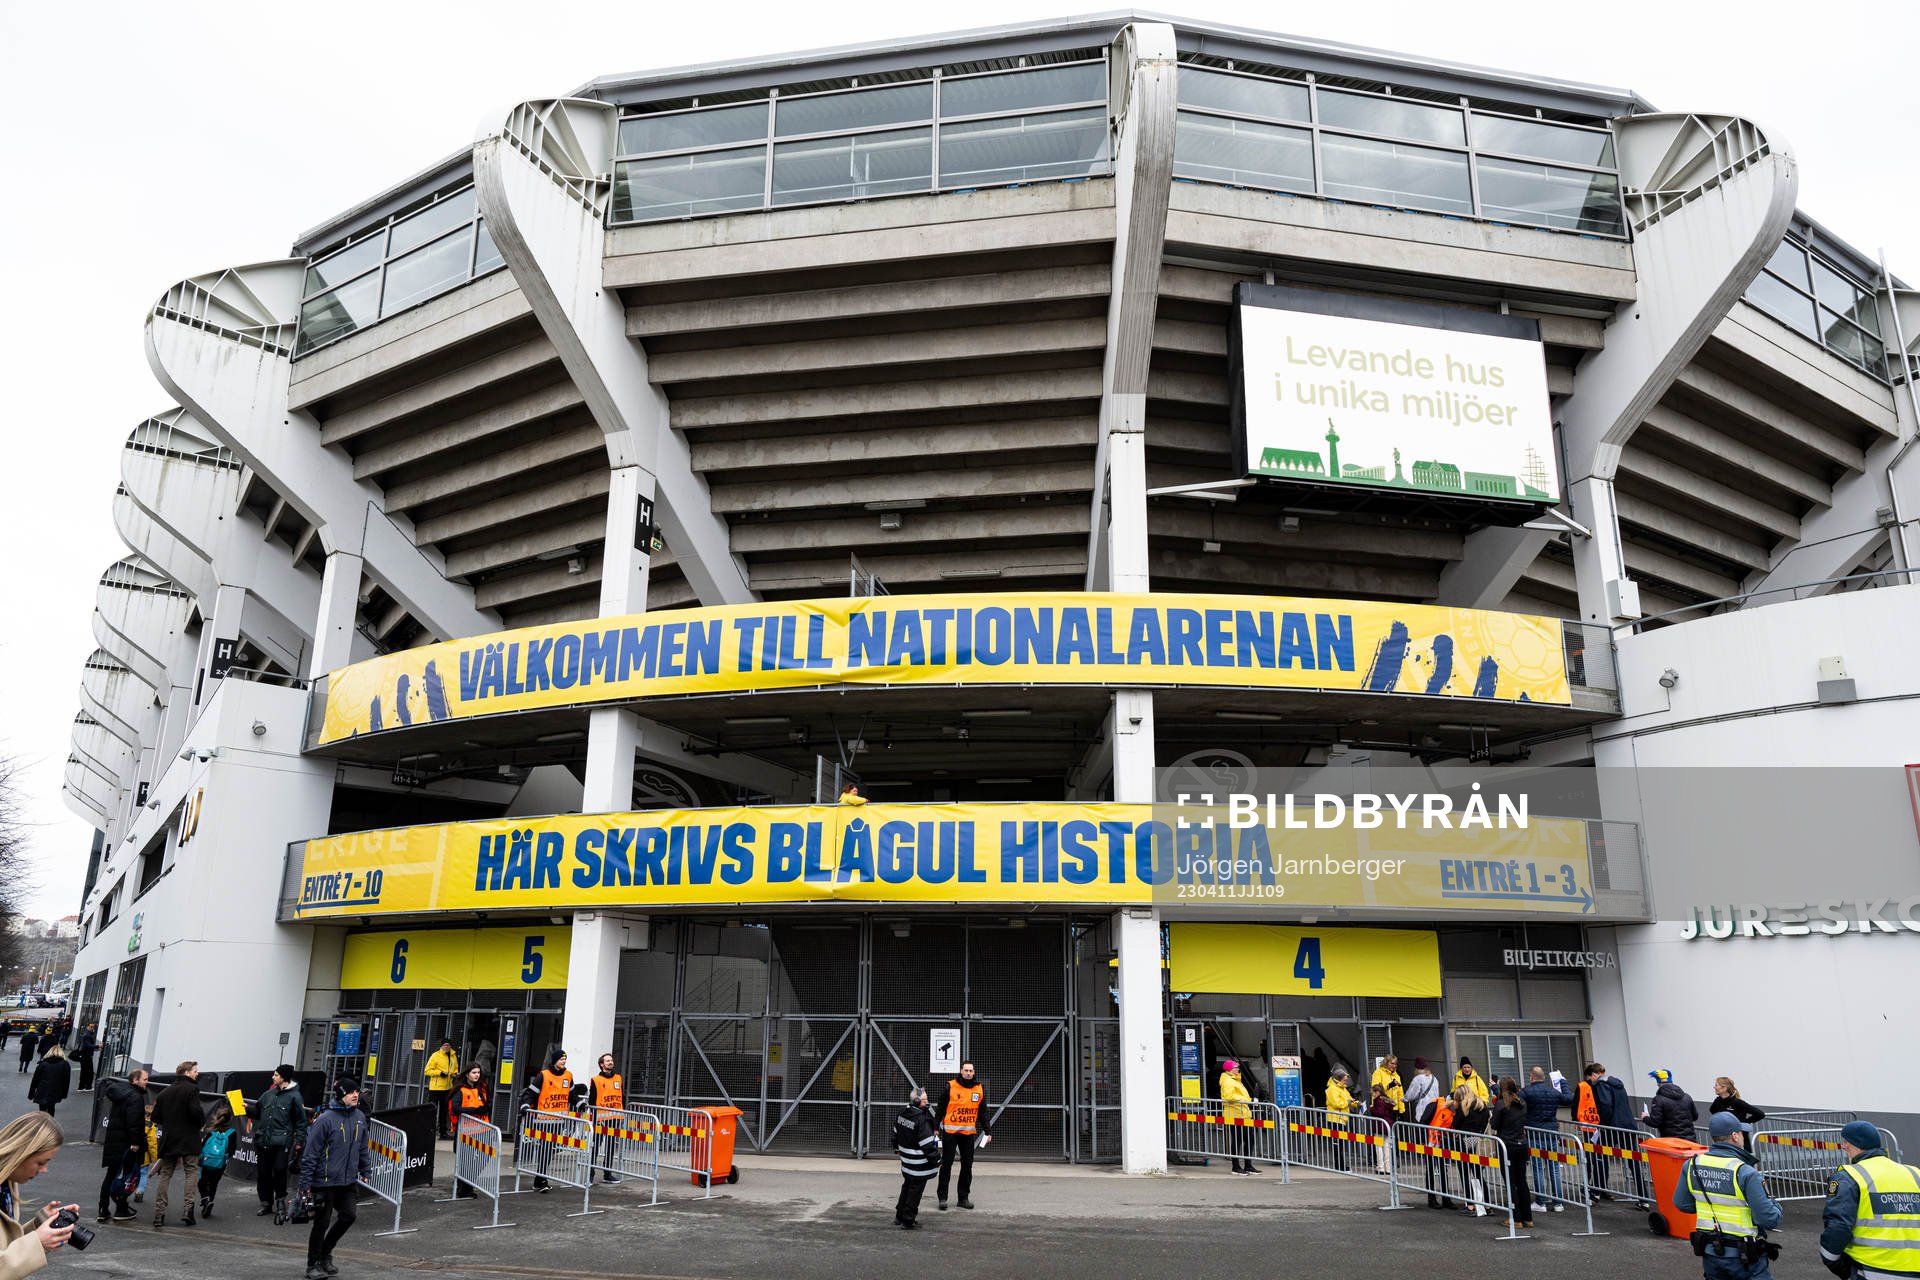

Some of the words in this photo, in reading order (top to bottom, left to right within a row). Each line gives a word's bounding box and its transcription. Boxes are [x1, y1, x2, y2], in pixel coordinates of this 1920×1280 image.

[1286, 335, 1434, 379] Levande
[1446, 353, 1504, 387] hus
[1275, 372, 1282, 401] i
[1296, 379, 1389, 413] unika
[1402, 390, 1517, 427] miljöer
[640, 502, 650, 526] H
[218, 643, 232, 659] H
[460, 619, 723, 701] VÄLKOMMEN
[734, 614, 833, 672] TILL
[848, 606, 1355, 672] NATIONALARENAN
[475, 829, 563, 891] HÄR
[572, 823, 756, 889] SKRIVS
[767, 817, 987, 884] BLÅGUL
[1000, 819, 1276, 885] HISTORIA
[1440, 859, 1523, 892] ENTRÉ
[303, 871, 341, 902] ENTRÉ
[390, 938, 409, 984] 6
[521, 935, 545, 984] 5
[1294, 937, 1325, 989] 4
[1503, 949, 1617, 970] BILJETTKASSA
[1702, 1179, 1722, 1189] VAKT
